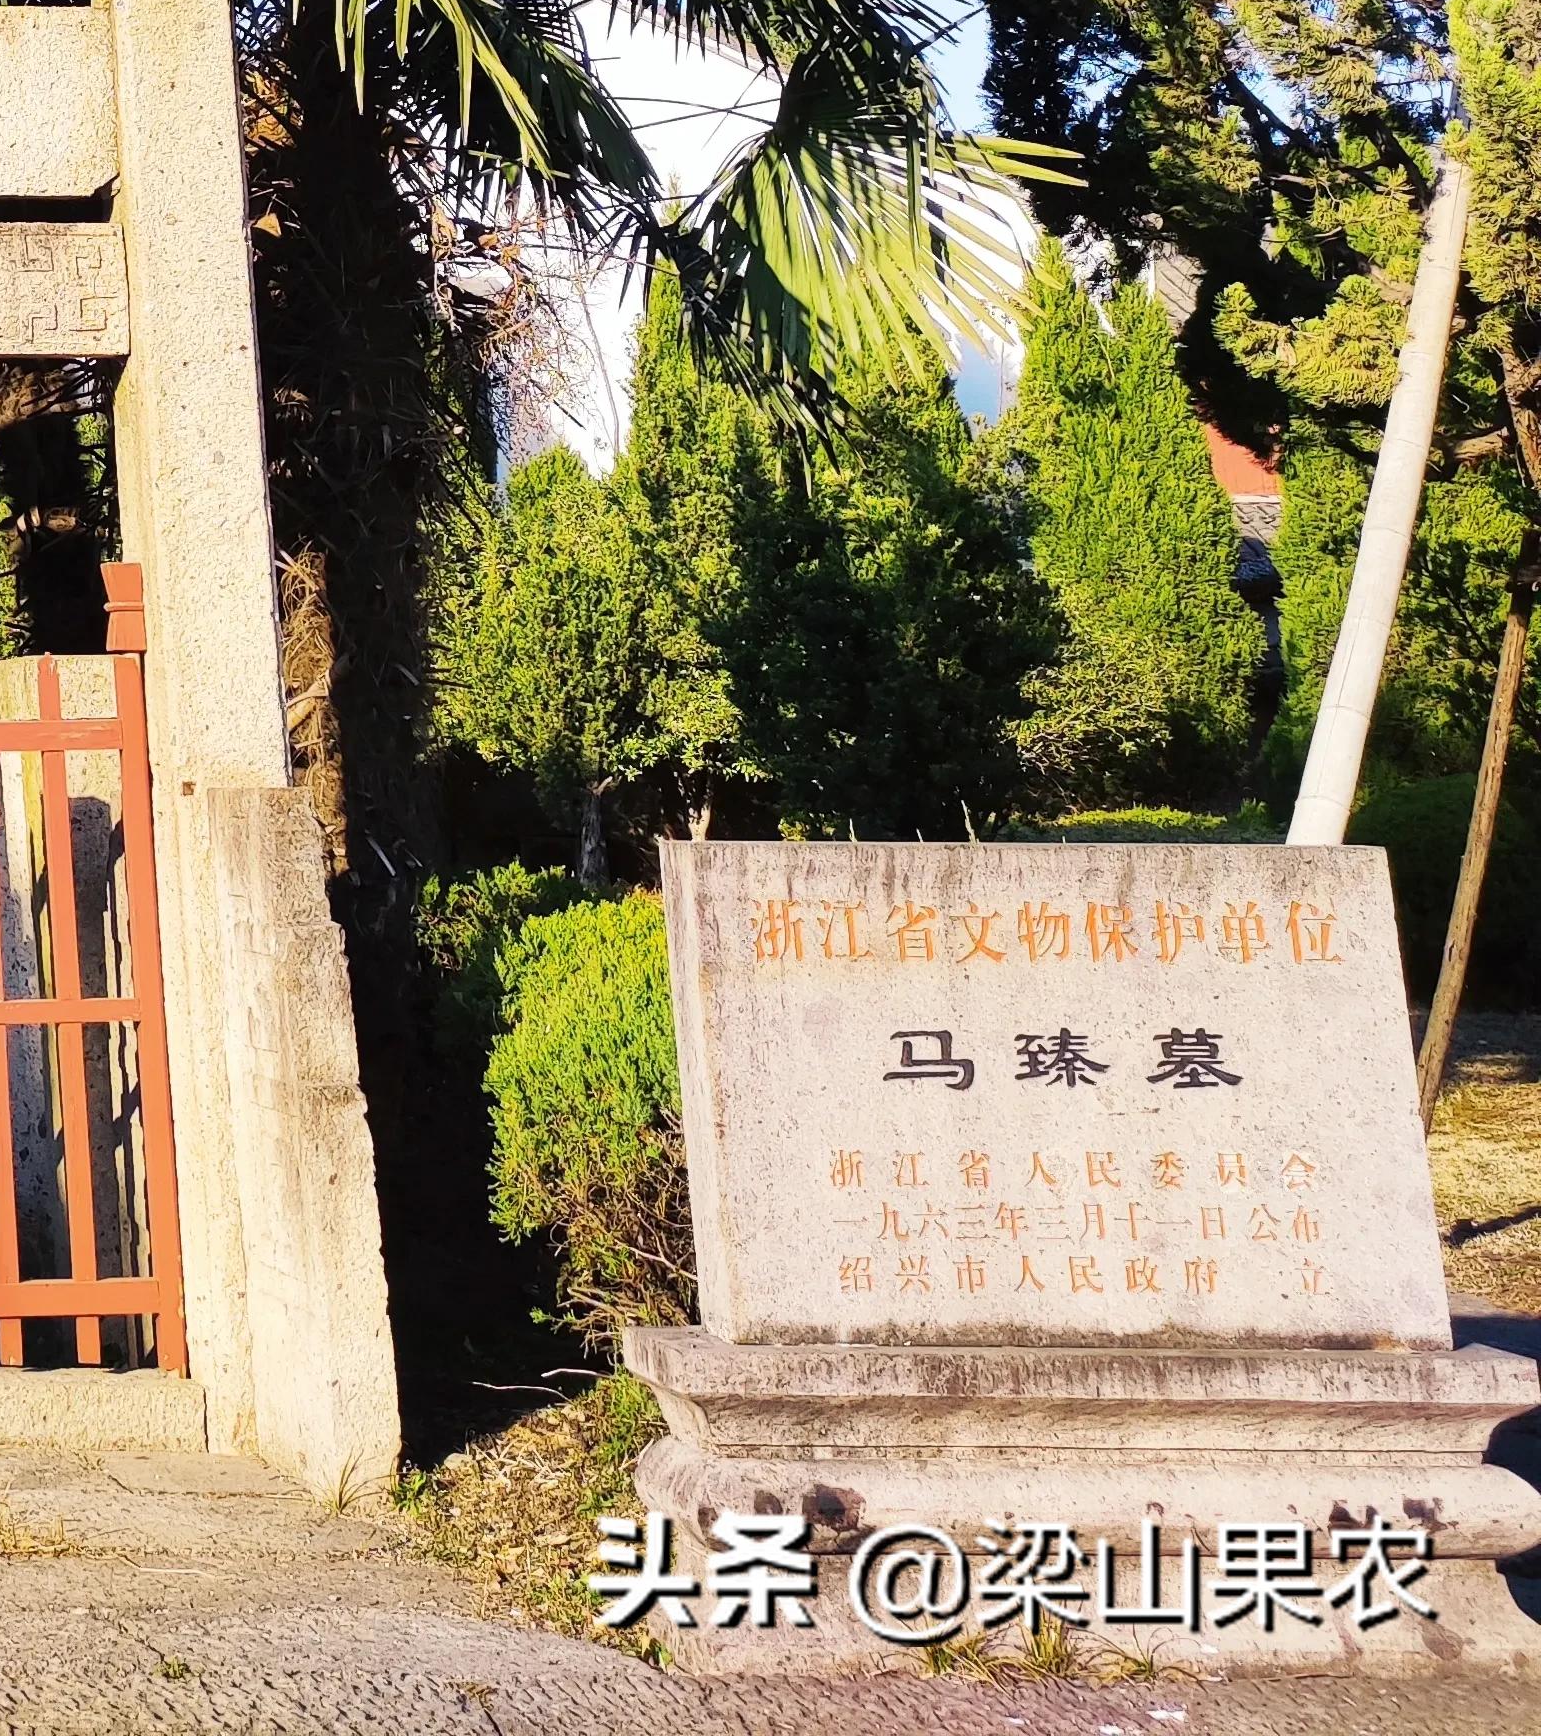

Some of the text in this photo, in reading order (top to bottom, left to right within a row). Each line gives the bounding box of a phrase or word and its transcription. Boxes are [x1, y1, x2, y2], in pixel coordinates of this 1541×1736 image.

[749, 898, 1344, 967] 浙江省文物保护单位
[882, 1027, 1244, 1092] 马臻墓
[829, 1149, 1316, 1191] 浙江省人民委员会
[832, 1201, 1320, 1242] 一九六三年三月十一日公布
